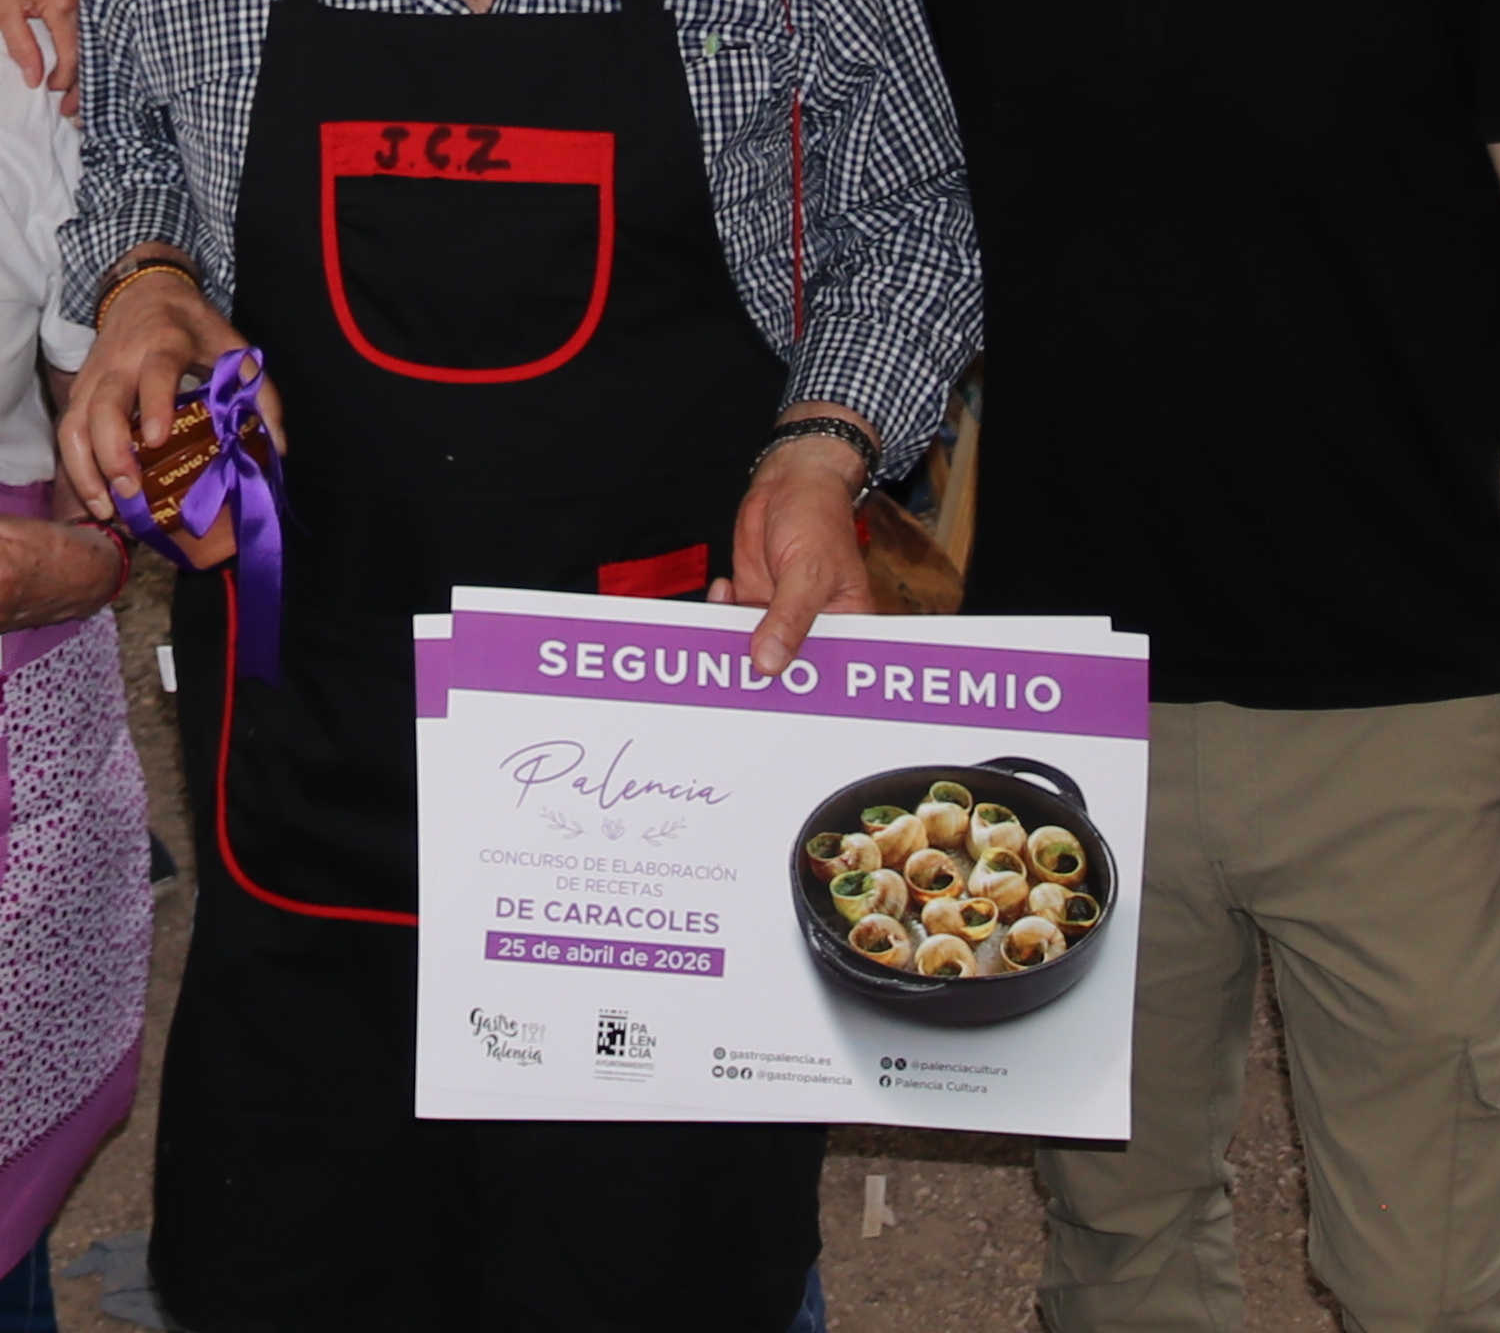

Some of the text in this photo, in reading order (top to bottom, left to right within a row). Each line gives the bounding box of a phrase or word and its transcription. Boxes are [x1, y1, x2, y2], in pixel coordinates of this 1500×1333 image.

[537, 640, 1063, 713] SEGUNDO PREMIO
[499, 738, 733, 810] Palencia
[479, 848, 737, 882] CONCURSO DE ELABORACIÓN
[556, 876, 663, 898] DE RECETAS
[495, 897, 721, 934] DE CARACOLES
[498, 938, 712, 972] 25 de abril de 2026
[630, 1022, 648, 1034] PA
[480, 1034, 543, 1066] Palencia
[629, 1035, 656, 1047] LEN
[628, 1046, 652, 1059] CIA
[729, 1049, 831, 1066] gastropalencia.es
[757, 1070, 853, 1085] @gastropalencia
[911, 1060, 1008, 1076] @palenciacultura
[895, 1077, 988, 1094] Palencia Cultura
